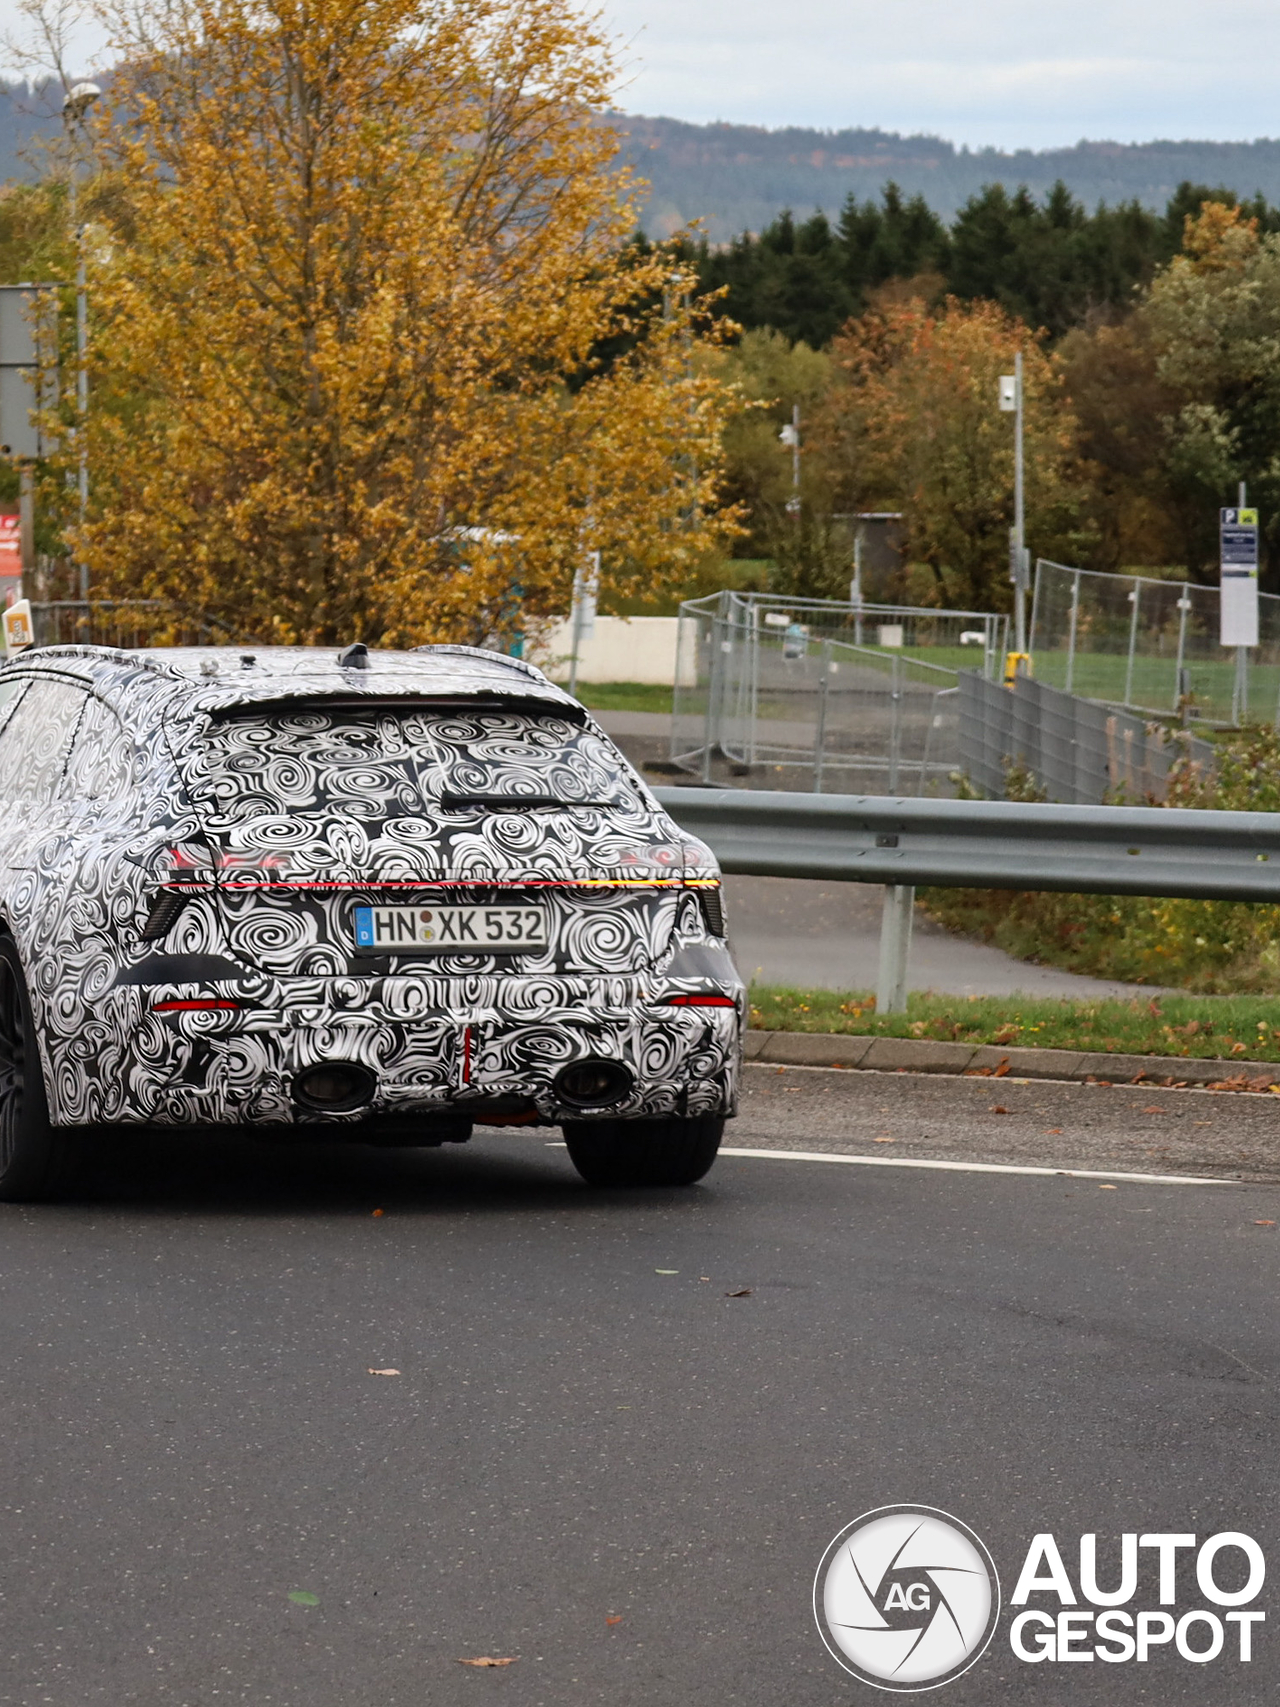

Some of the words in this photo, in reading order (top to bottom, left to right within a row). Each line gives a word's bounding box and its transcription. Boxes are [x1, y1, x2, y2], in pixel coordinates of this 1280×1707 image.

[361, 931, 369, 940] D
[375, 911, 417, 941] HN
[438, 911, 478, 940] XK
[485, 911, 543, 940] 532
